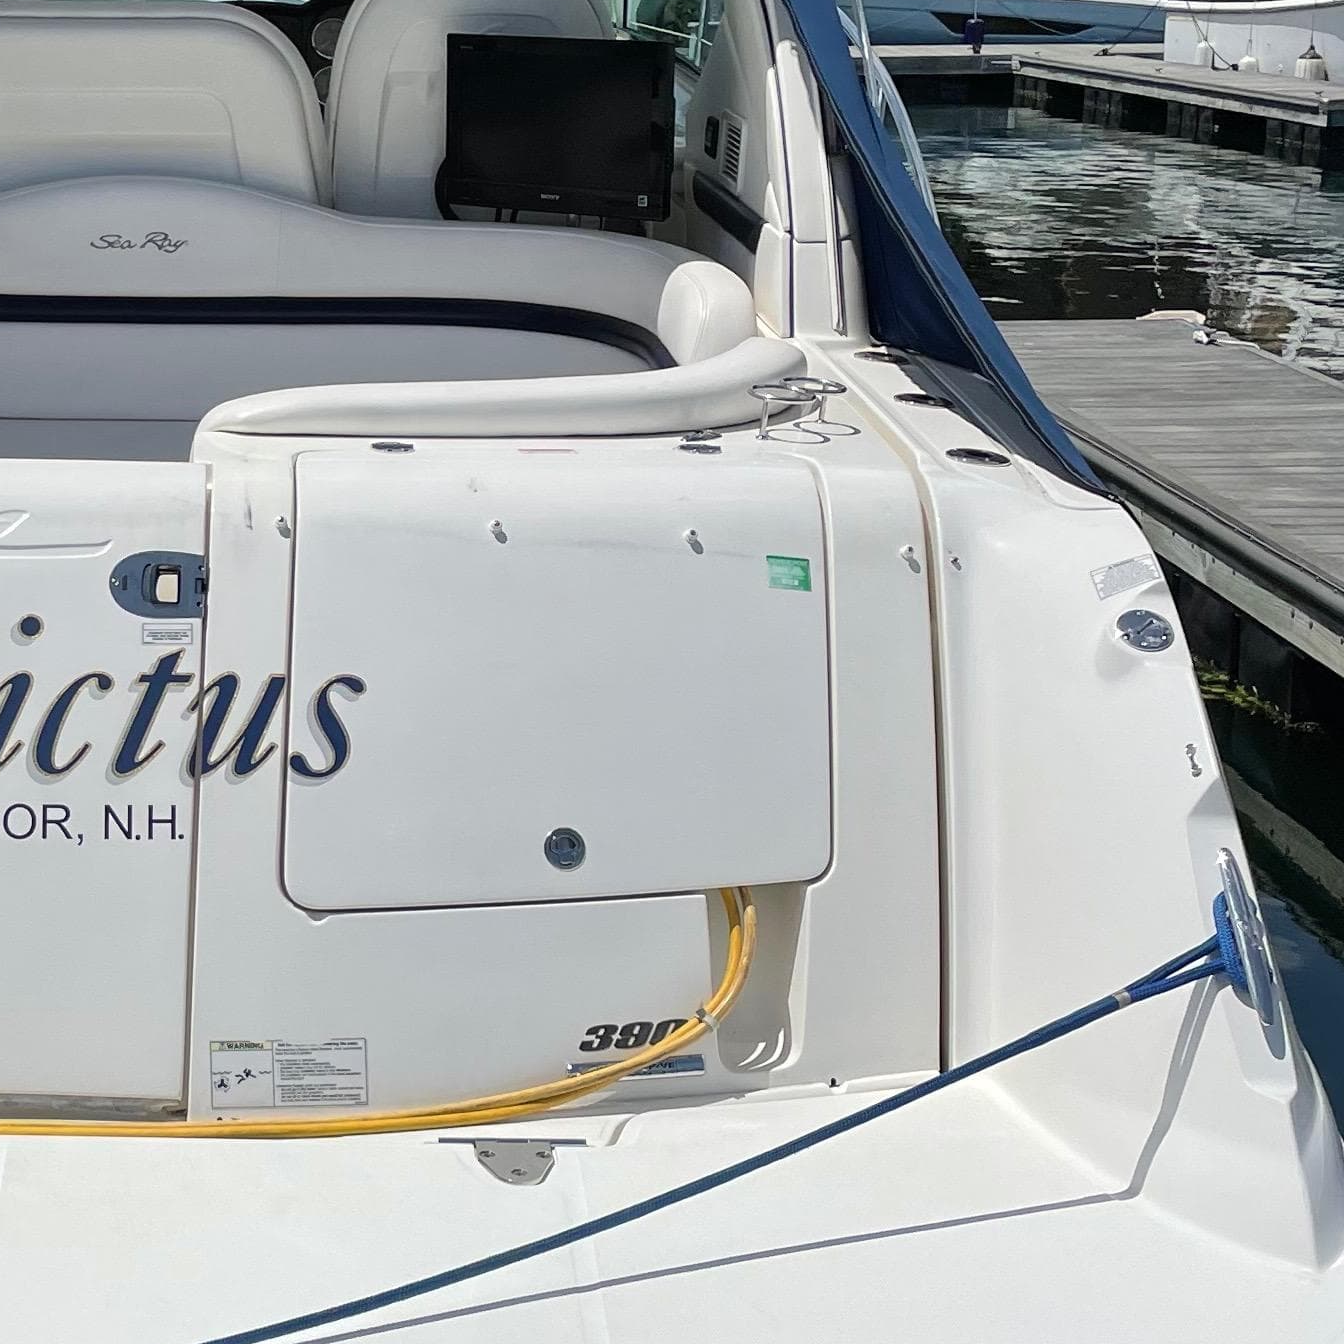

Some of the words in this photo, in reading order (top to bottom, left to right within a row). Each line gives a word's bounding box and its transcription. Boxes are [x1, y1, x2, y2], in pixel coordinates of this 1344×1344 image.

[90, 234, 137, 249] Sea
[139, 231, 189, 253] Ray
[104, 804, 185, 841] N.H.
